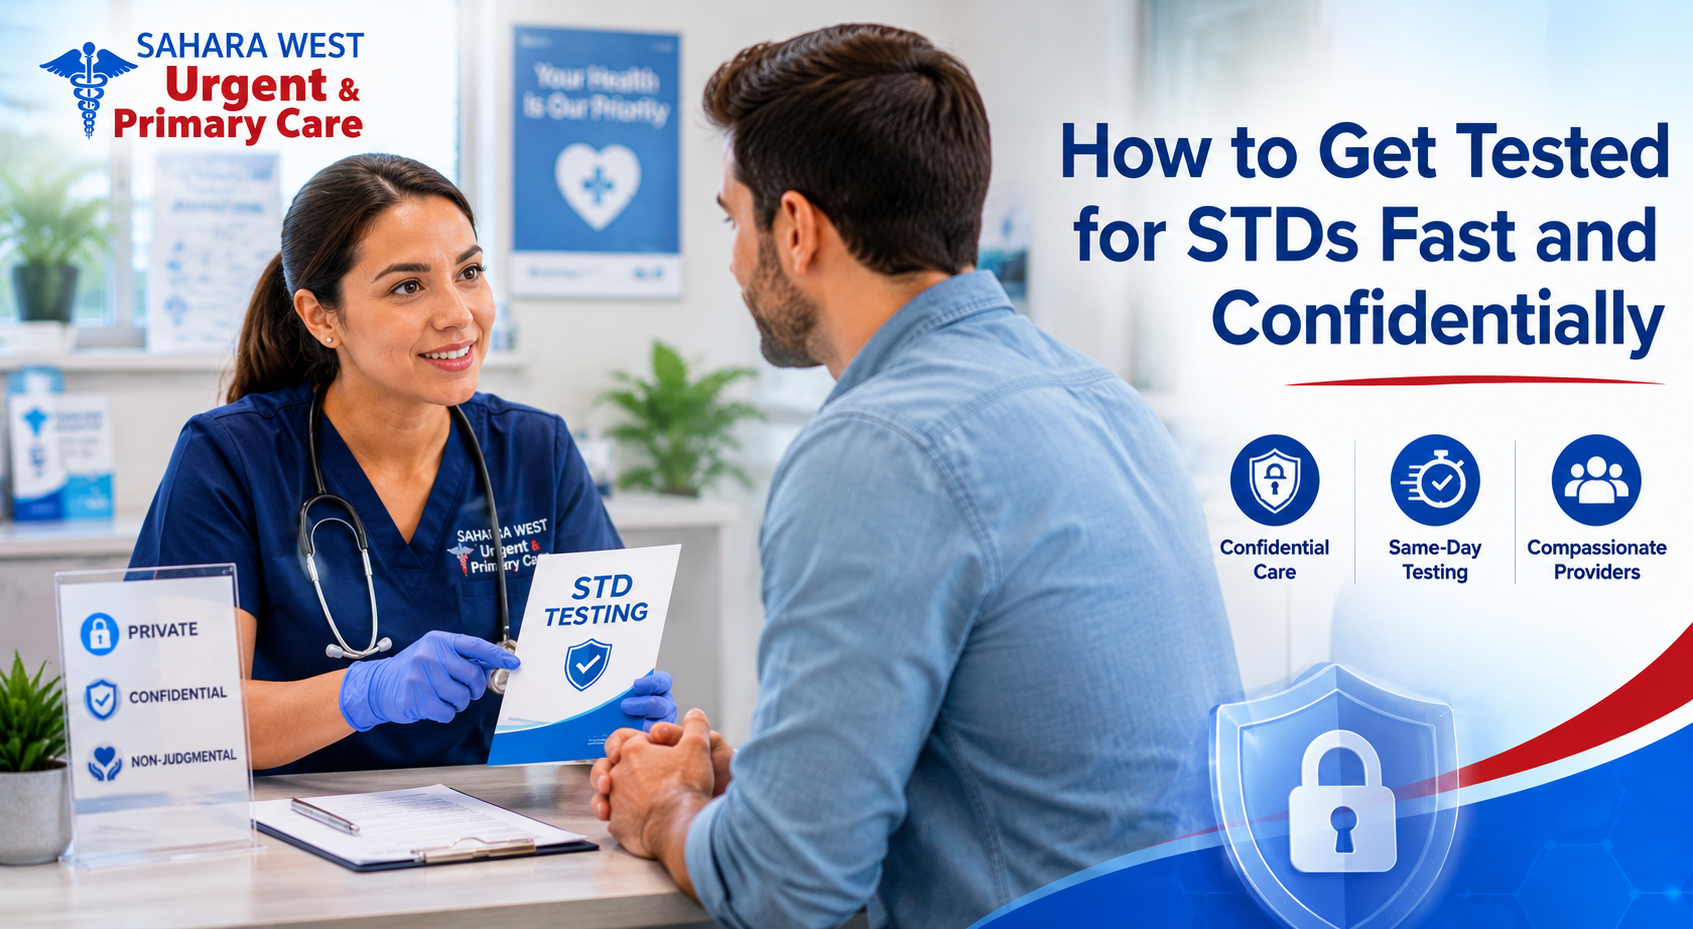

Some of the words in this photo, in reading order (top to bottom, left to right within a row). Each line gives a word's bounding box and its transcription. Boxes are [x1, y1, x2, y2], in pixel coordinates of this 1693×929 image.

[534, 61, 585, 91] Your
[513, 518, 547, 537] WEST
[531, 540, 540, 551] &
[571, 574, 633, 600] STD
[545, 602, 648, 626] TESTING
[128, 622, 198, 639] PRIVATE
[129, 686, 227, 704] CONFIDENTIAL
[131, 748, 237, 767] NON-JUDGMENTAL
